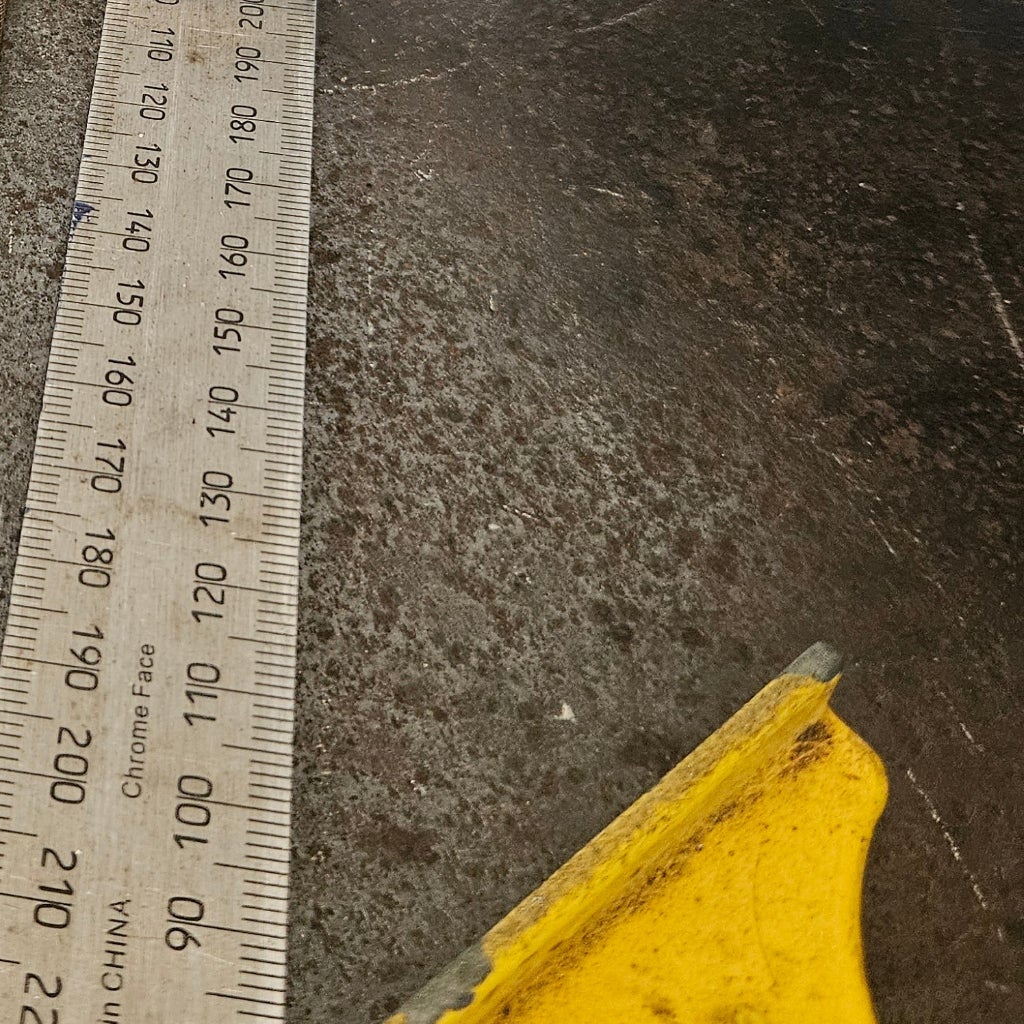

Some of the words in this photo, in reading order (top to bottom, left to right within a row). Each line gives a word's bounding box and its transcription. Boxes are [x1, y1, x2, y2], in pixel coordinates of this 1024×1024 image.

[147, 27, 176, 62] 110
[234, 46, 262, 83] 190
[139, 83, 169, 121] 120
[229, 105, 258, 144] 180
[131, 143, 162, 184] 130
[224, 168, 253, 209] 170
[122, 209, 154, 253] 140
[218, 234, 249, 280] 160
[112, 279, 146, 326] 150
[212, 308, 244, 356] 150
[102, 355, 137, 407] 160
[206, 385, 239, 438] 140
[91, 438, 127, 494] 170
[199, 470, 233, 526] 130
[78, 528, 116, 589] 180
[191, 562, 227, 623] 120
[65, 625, 104, 691] 190
[132, 644, 155, 697] Face
[183, 662, 221, 726] 110
[50, 726, 92, 805] 200
[121, 706, 150, 799] Chrome
[173, 775, 213, 849] 100
[33, 847, 77, 929] 210
[101, 898, 131, 991] CHINA
[164, 896, 205, 951] 90
